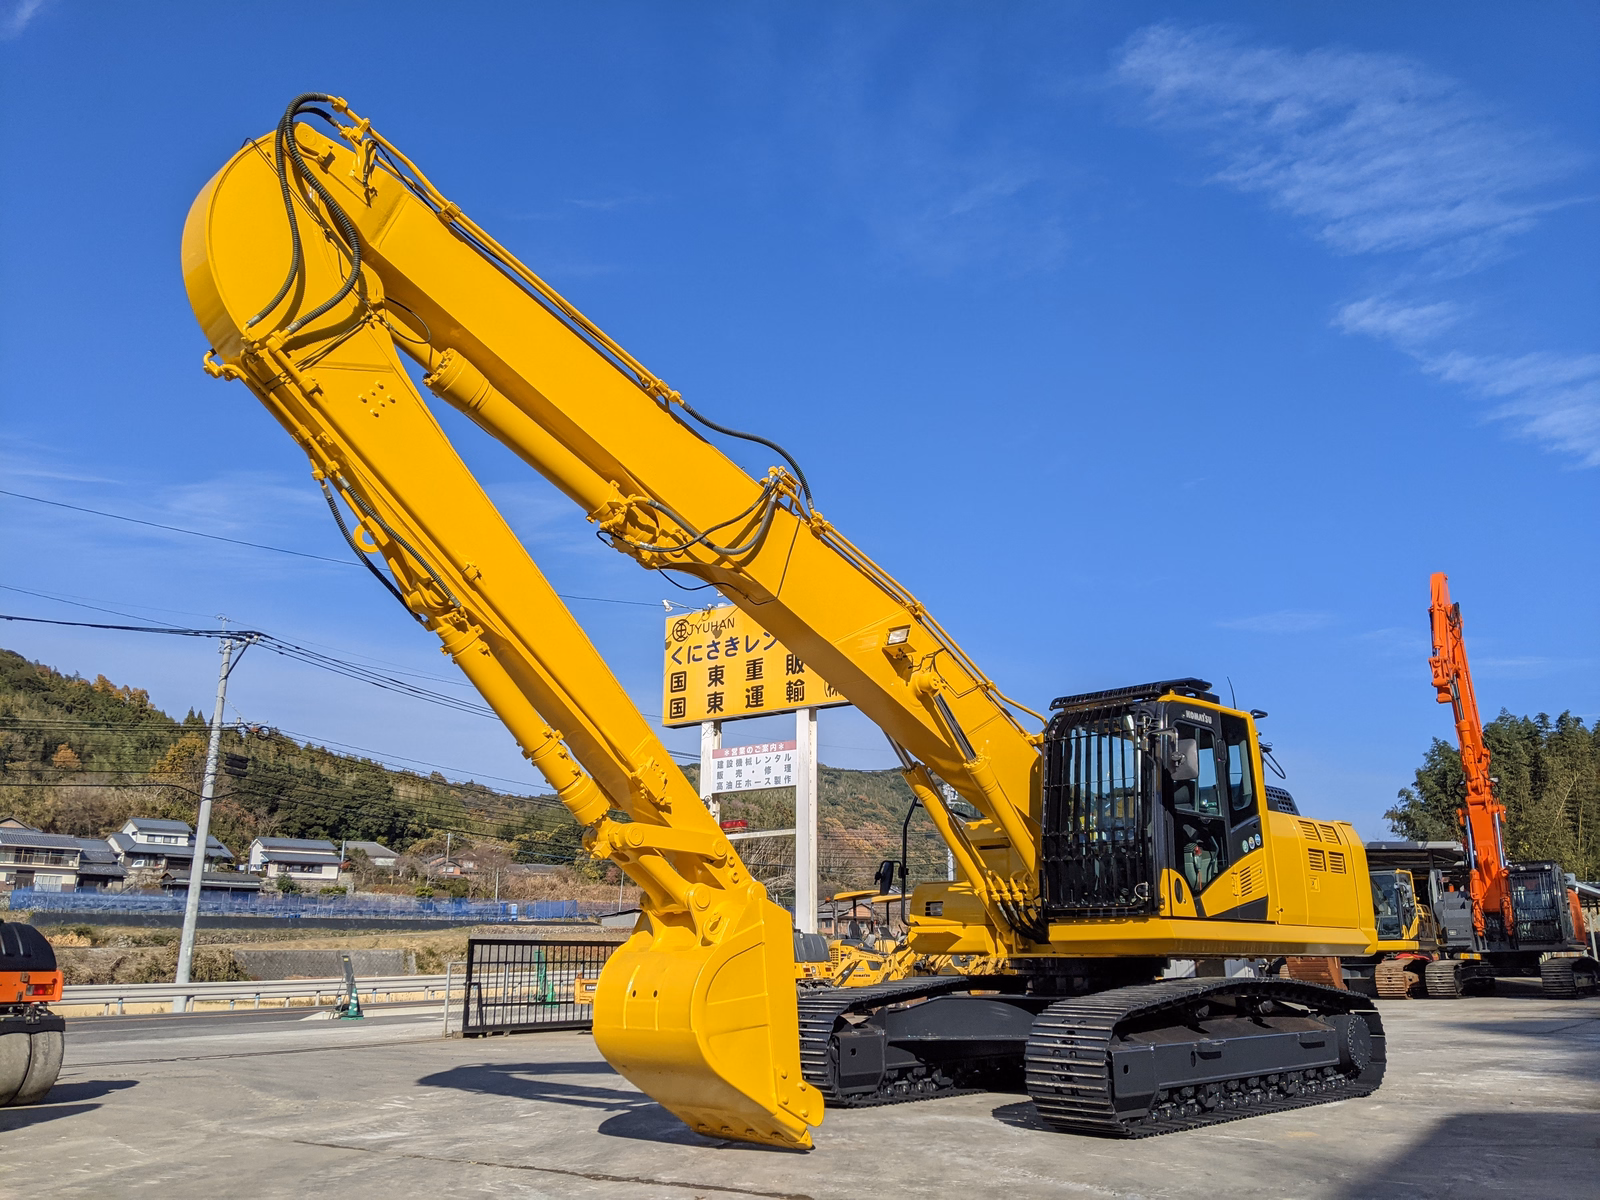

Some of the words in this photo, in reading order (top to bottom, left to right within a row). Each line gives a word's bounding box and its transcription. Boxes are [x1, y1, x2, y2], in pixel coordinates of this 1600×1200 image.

[671, 631, 778, 665] くにさきレン
[1185, 709, 1213, 725] KOMATSU
[716, 752, 792, 770] 建設機械レンタル
